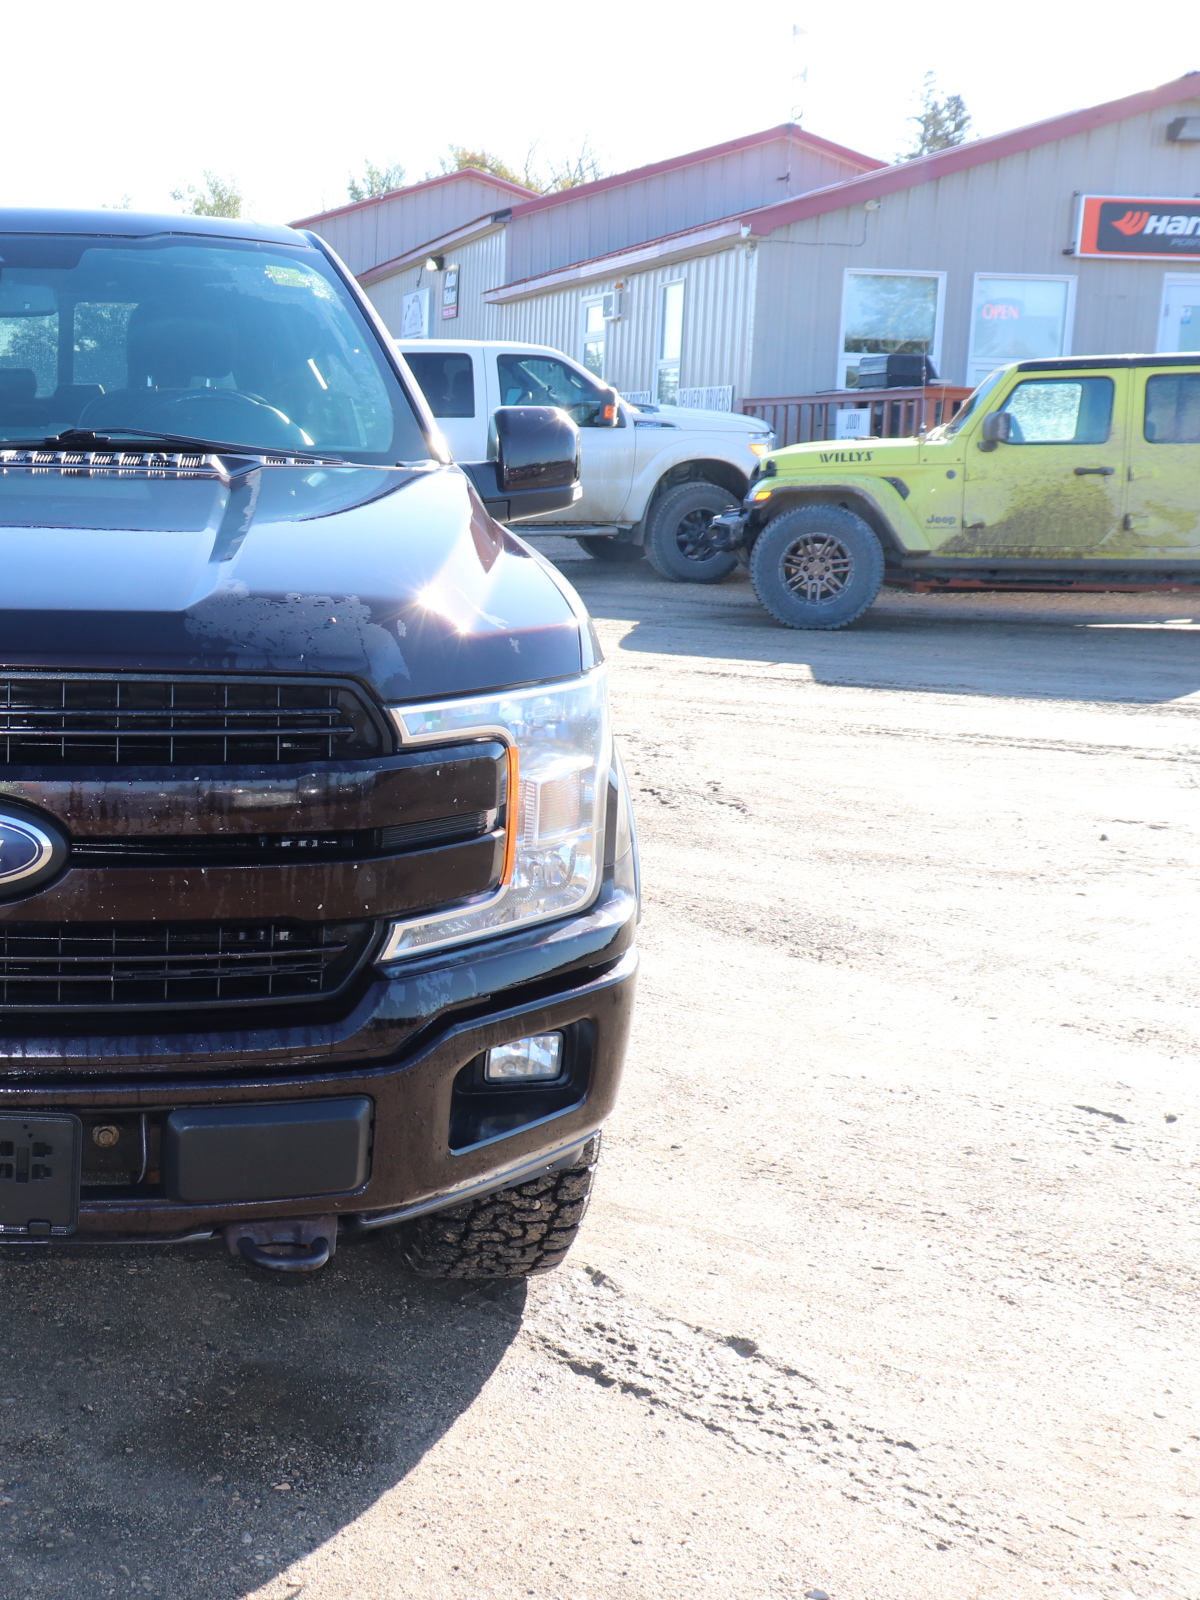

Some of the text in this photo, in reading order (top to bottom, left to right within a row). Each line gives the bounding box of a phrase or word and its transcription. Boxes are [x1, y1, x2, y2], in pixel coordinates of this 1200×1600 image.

[982, 304, 1019, 319] OPEN
[706, 387, 730, 411] DRIVERS
[846, 413, 861, 429] JODY
[820, 451, 873, 462] WILLYS
[927, 515, 956, 525] Jeep
